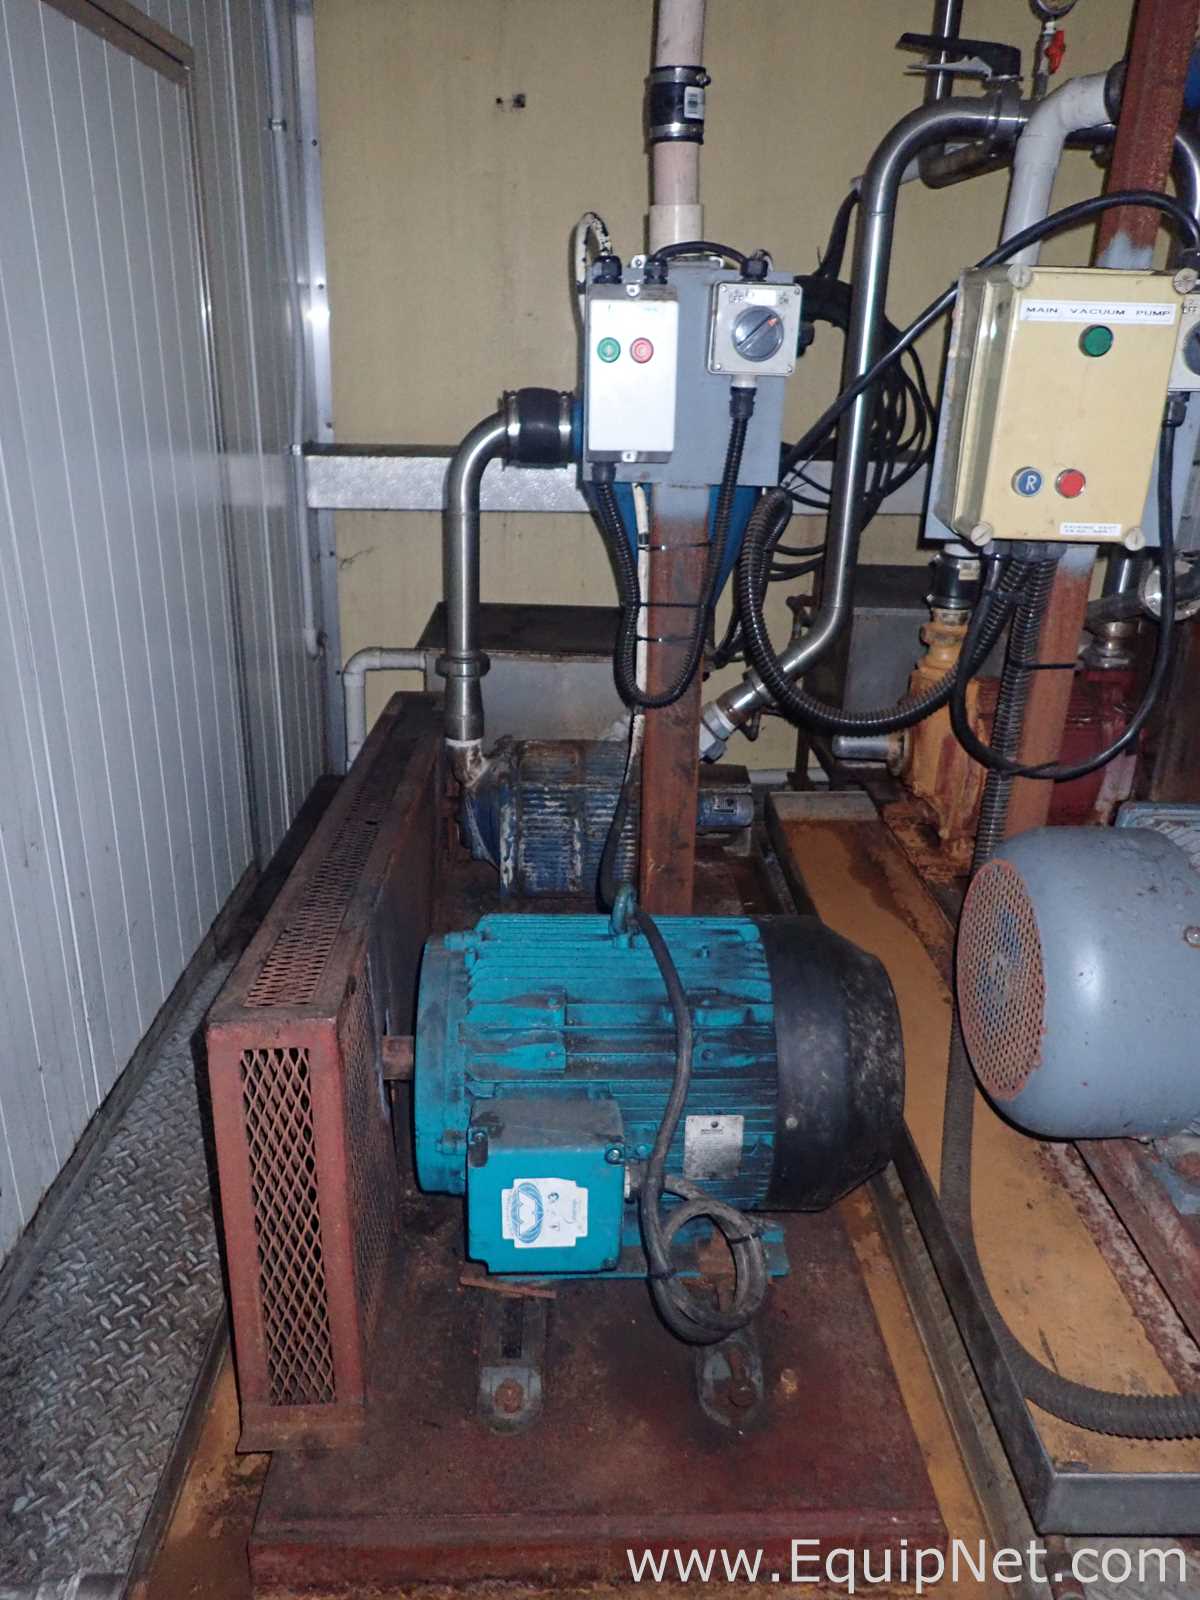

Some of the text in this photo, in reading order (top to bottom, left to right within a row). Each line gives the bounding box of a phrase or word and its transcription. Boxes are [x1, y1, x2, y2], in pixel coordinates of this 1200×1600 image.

[1025, 306, 1171, 318] MAIN VACUUM PUMP
[1026, 475, 1037, 491] R
